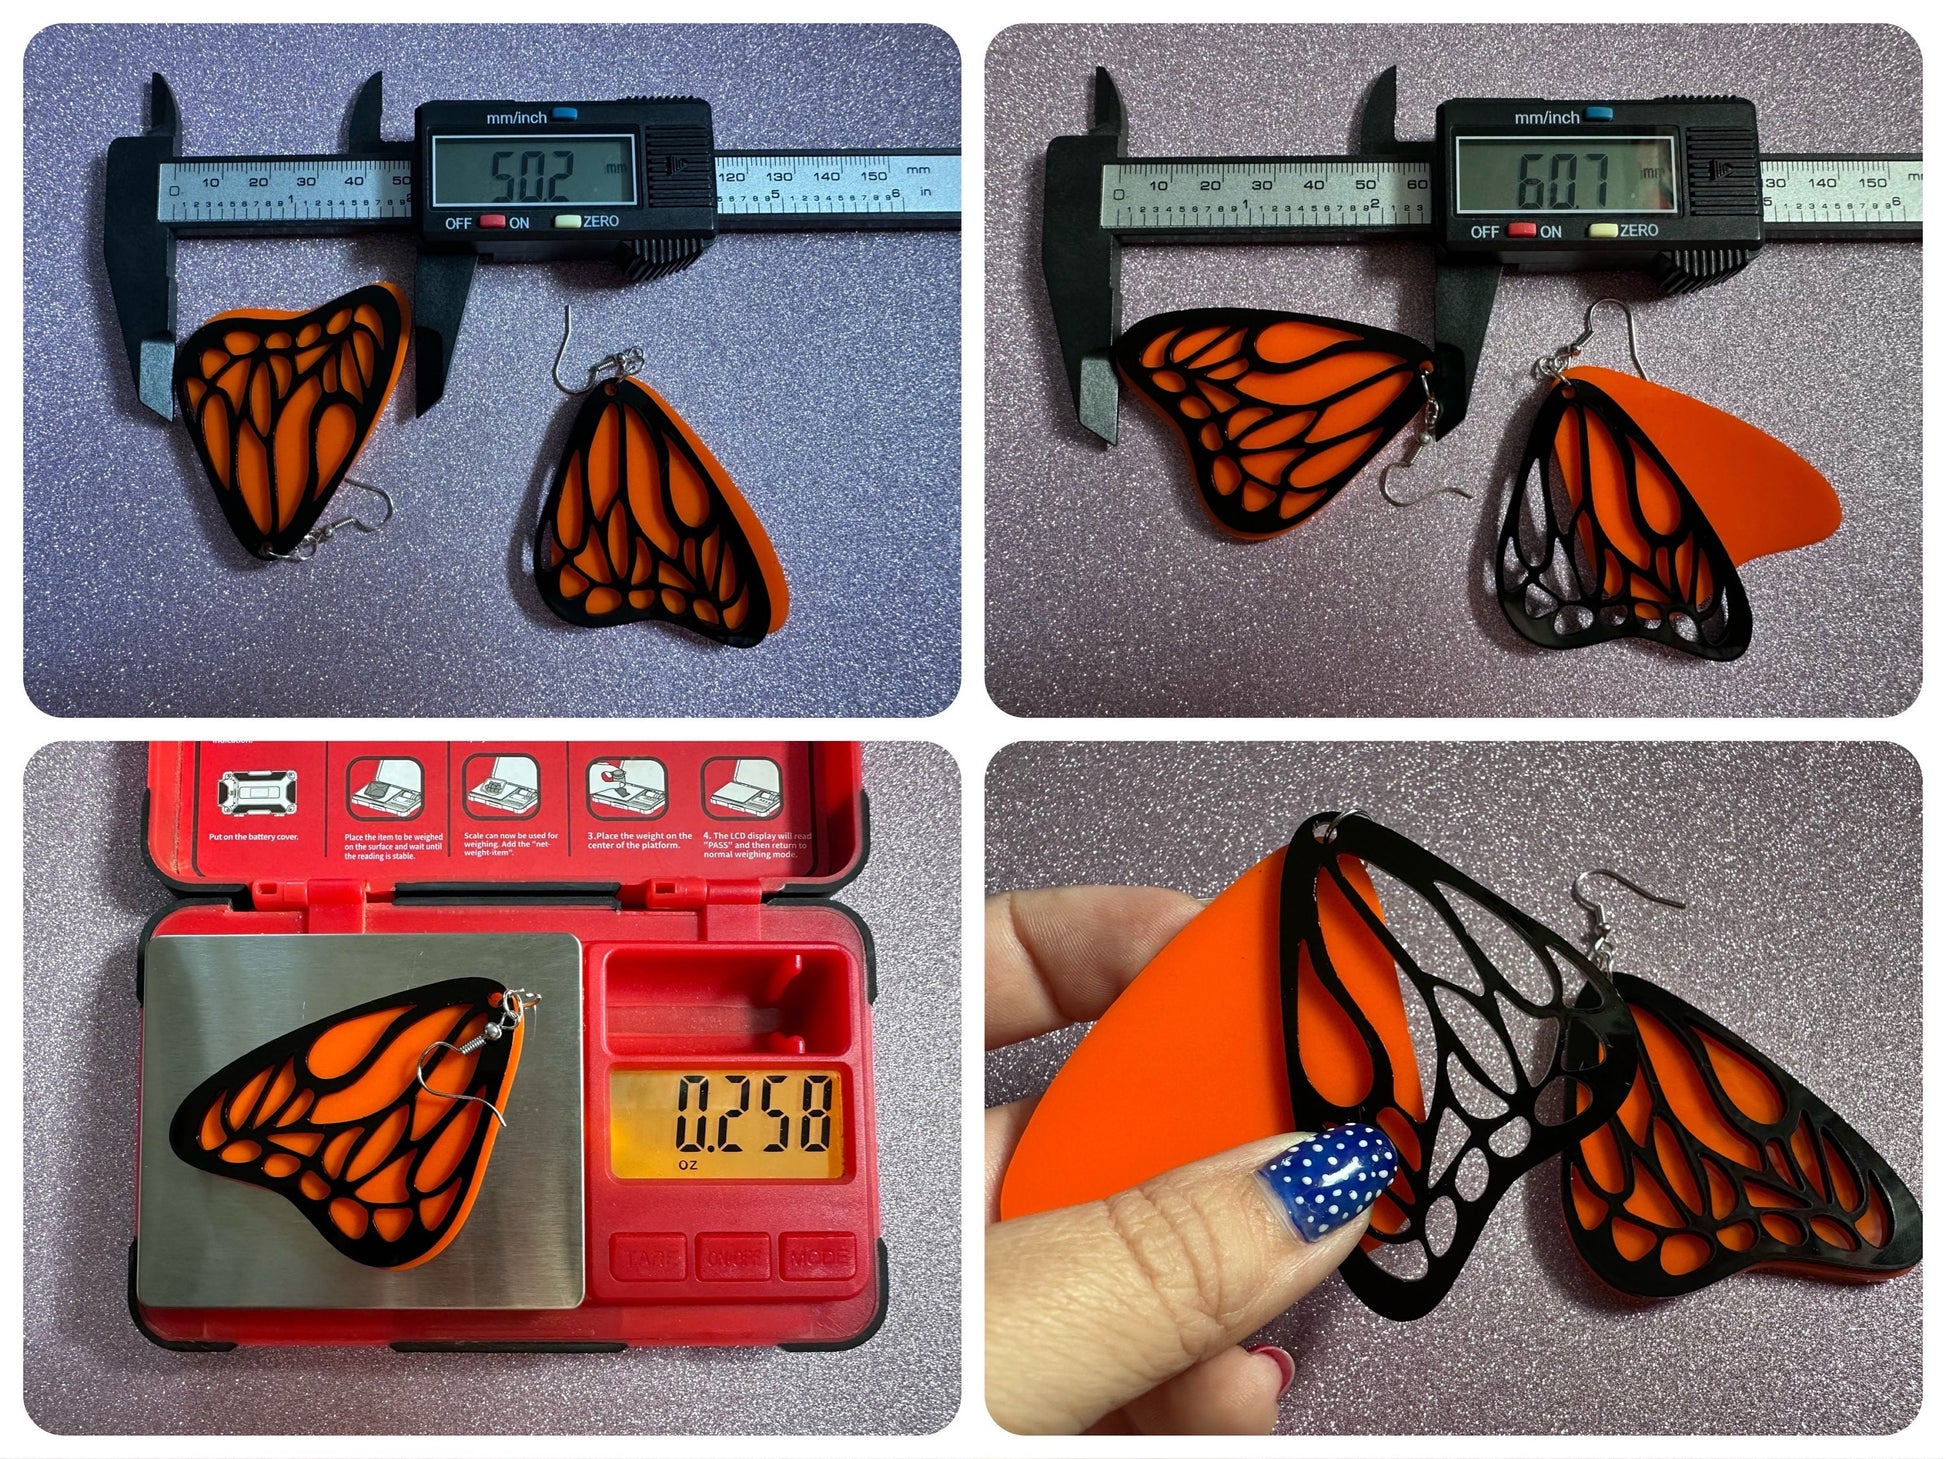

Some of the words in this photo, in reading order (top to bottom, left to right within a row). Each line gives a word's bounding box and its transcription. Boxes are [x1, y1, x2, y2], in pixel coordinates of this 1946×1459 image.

[487, 111, 547, 124] mm/inch
[1515, 111, 1580, 124] mm/inch
[203, 178, 219, 187] 10
[249, 178, 268, 187] 20
[297, 177, 316, 186] 30
[345, 177, 363, 185] 40
[392, 176, 411, 185] 50
[719, 173, 745, 182] 120
[767, 173, 792, 181] 130
[814, 172, 840, 181] 140
[861, 172, 887, 180] 150
[1519, 154, 1608, 209] 60.7
[1150, 181, 1168, 190] 10
[1200, 181, 1221, 190] 20
[1252, 181, 1272, 190] 30
[1304, 180, 1324, 190] 40
[1356, 180, 1376, 189] 50
[1408, 180, 1428, 189] 60
[1809, 179, 1836, 187] 140
[1859, 179, 1887, 188] 150
[772, 190, 780, 198] 5
[892, 189, 900, 197] 6
[920, 187, 931, 196] in
[1371, 199, 1379, 208] 2
[1892, 197, 1901, 206] 6
[446, 217, 472, 229] OFF
[509, 217, 529, 229] ON
[583, 215, 619, 227] ZERO
[1471, 225, 1500, 238] OFF
[1540, 225, 1562, 238] ON
[1620, 224, 1658, 237] ZERO
[414, 833, 443, 842] weighed
[588, 832, 618, 840] 3.Place
[636, 832, 664, 841] weight
[748, 832, 775, 841] display
[642, 841, 680, 850] platform.
[358, 853, 384, 861] reading
[735, 851, 771, 859] weighing
[676, 1075, 832, 1152] 0.258
[790, 1249, 849, 1266] MODE
